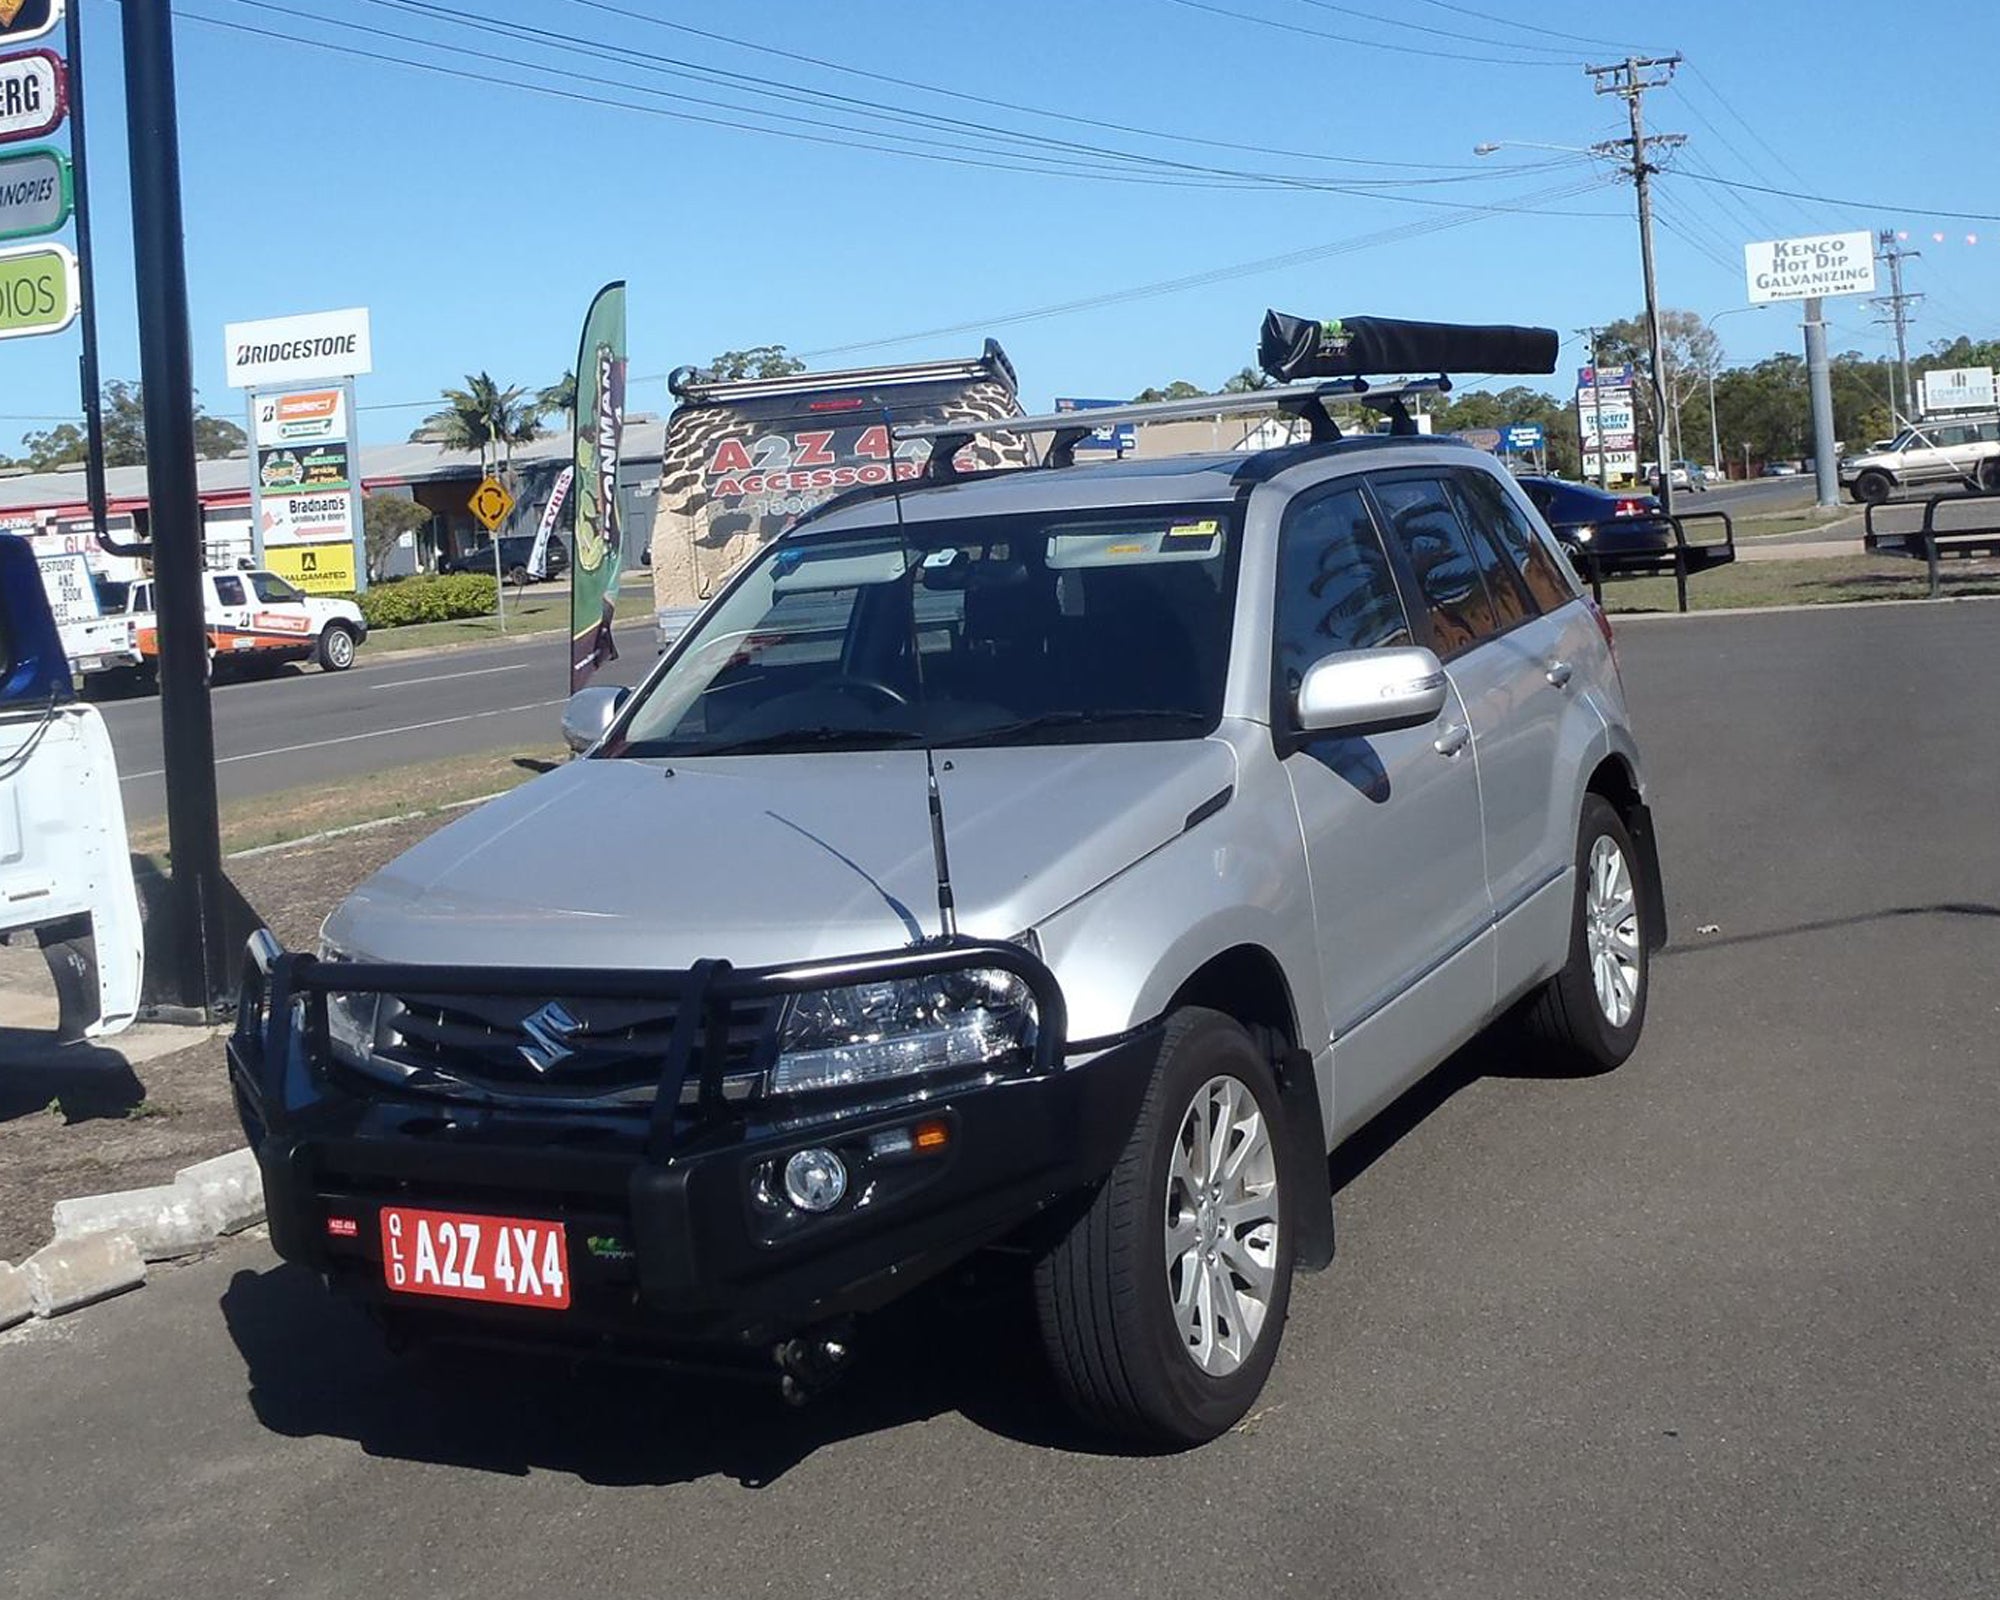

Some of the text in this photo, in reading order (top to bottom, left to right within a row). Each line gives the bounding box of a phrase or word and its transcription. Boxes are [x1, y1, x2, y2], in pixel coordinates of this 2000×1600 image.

[0, 275, 55, 318] IOS
[237, 334, 356, 366] BRIDGESTONE
[709, 430, 836, 475] A2Z
[289, 498, 346, 514] Bradnam's
[281, 571, 347, 582] MALGAMATED
[415, 1219, 563, 1298] A2Z 4X4
